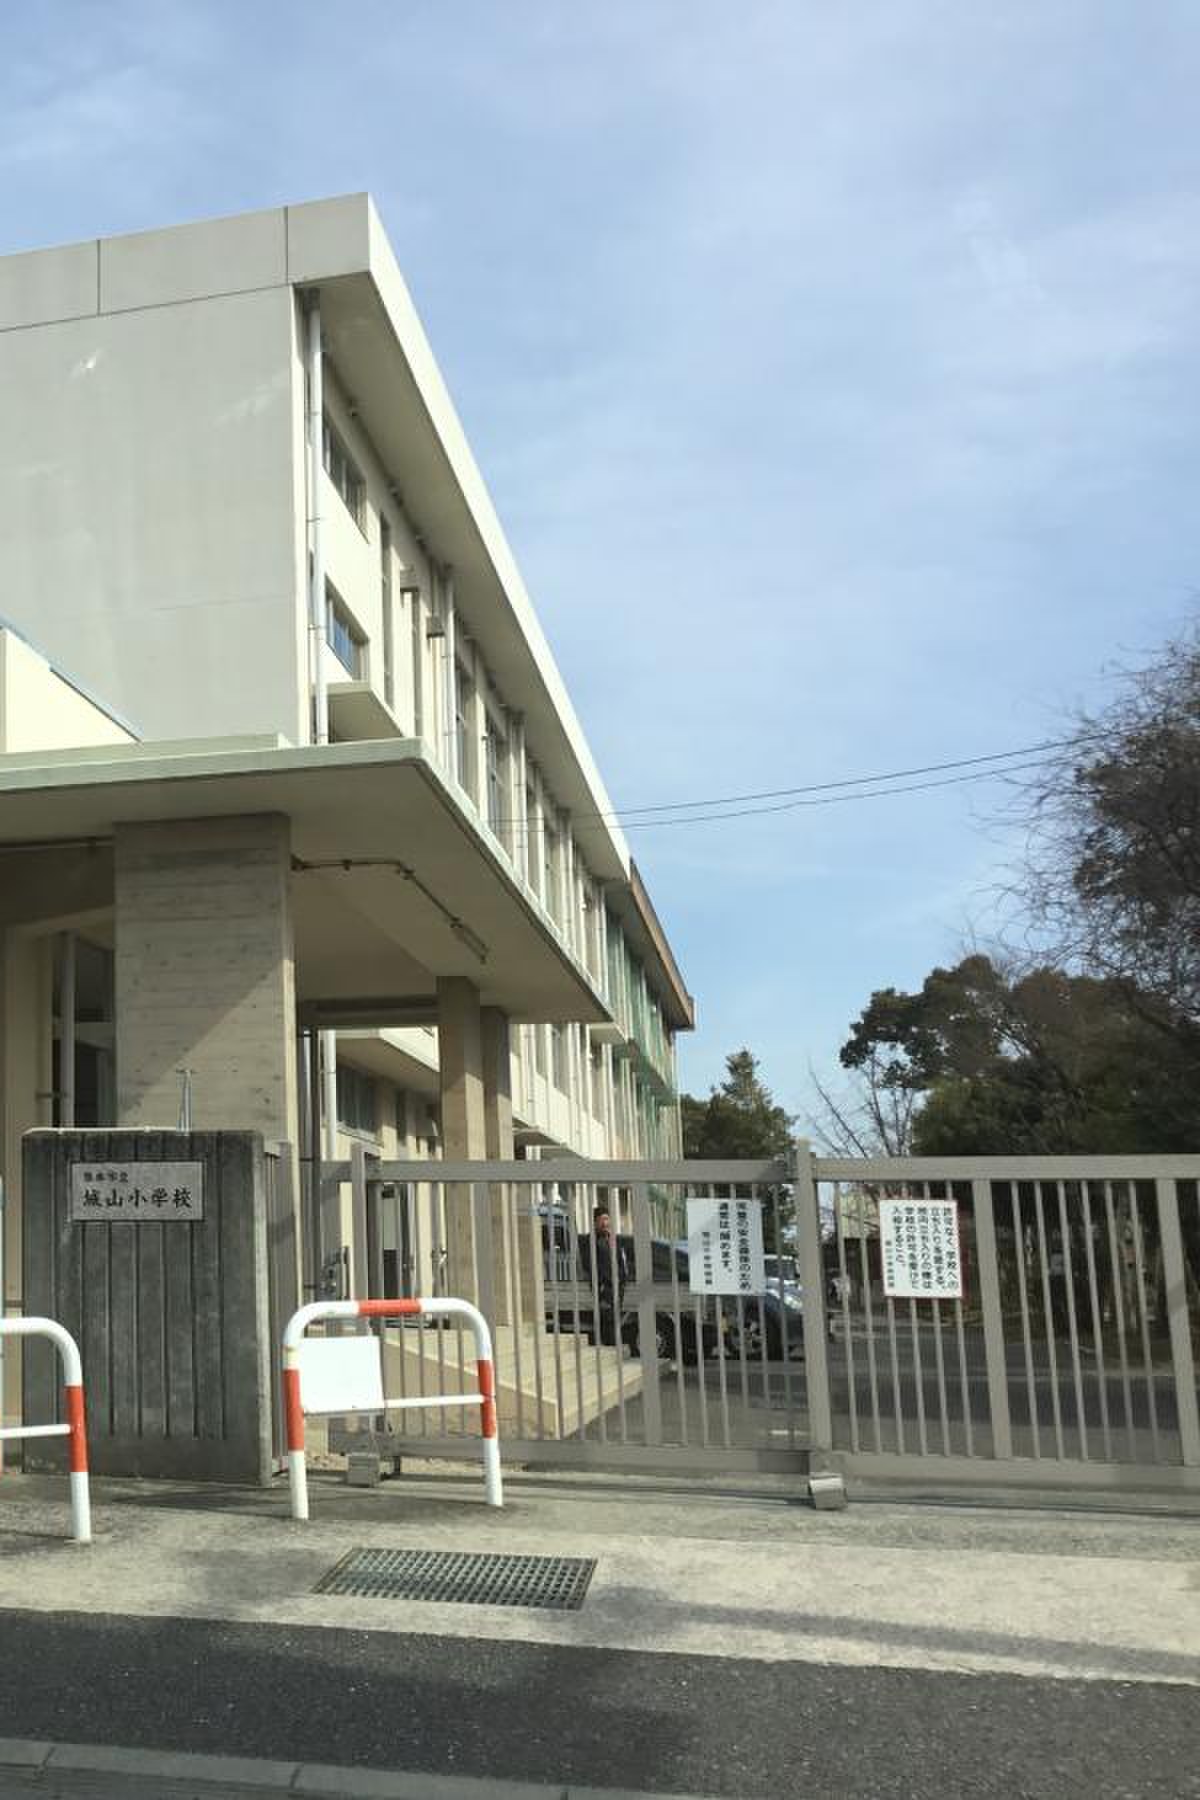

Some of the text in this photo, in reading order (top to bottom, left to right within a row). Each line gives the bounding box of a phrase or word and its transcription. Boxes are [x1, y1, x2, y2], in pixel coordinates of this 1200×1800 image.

[82, 1187, 192, 1209] 城山小学校
